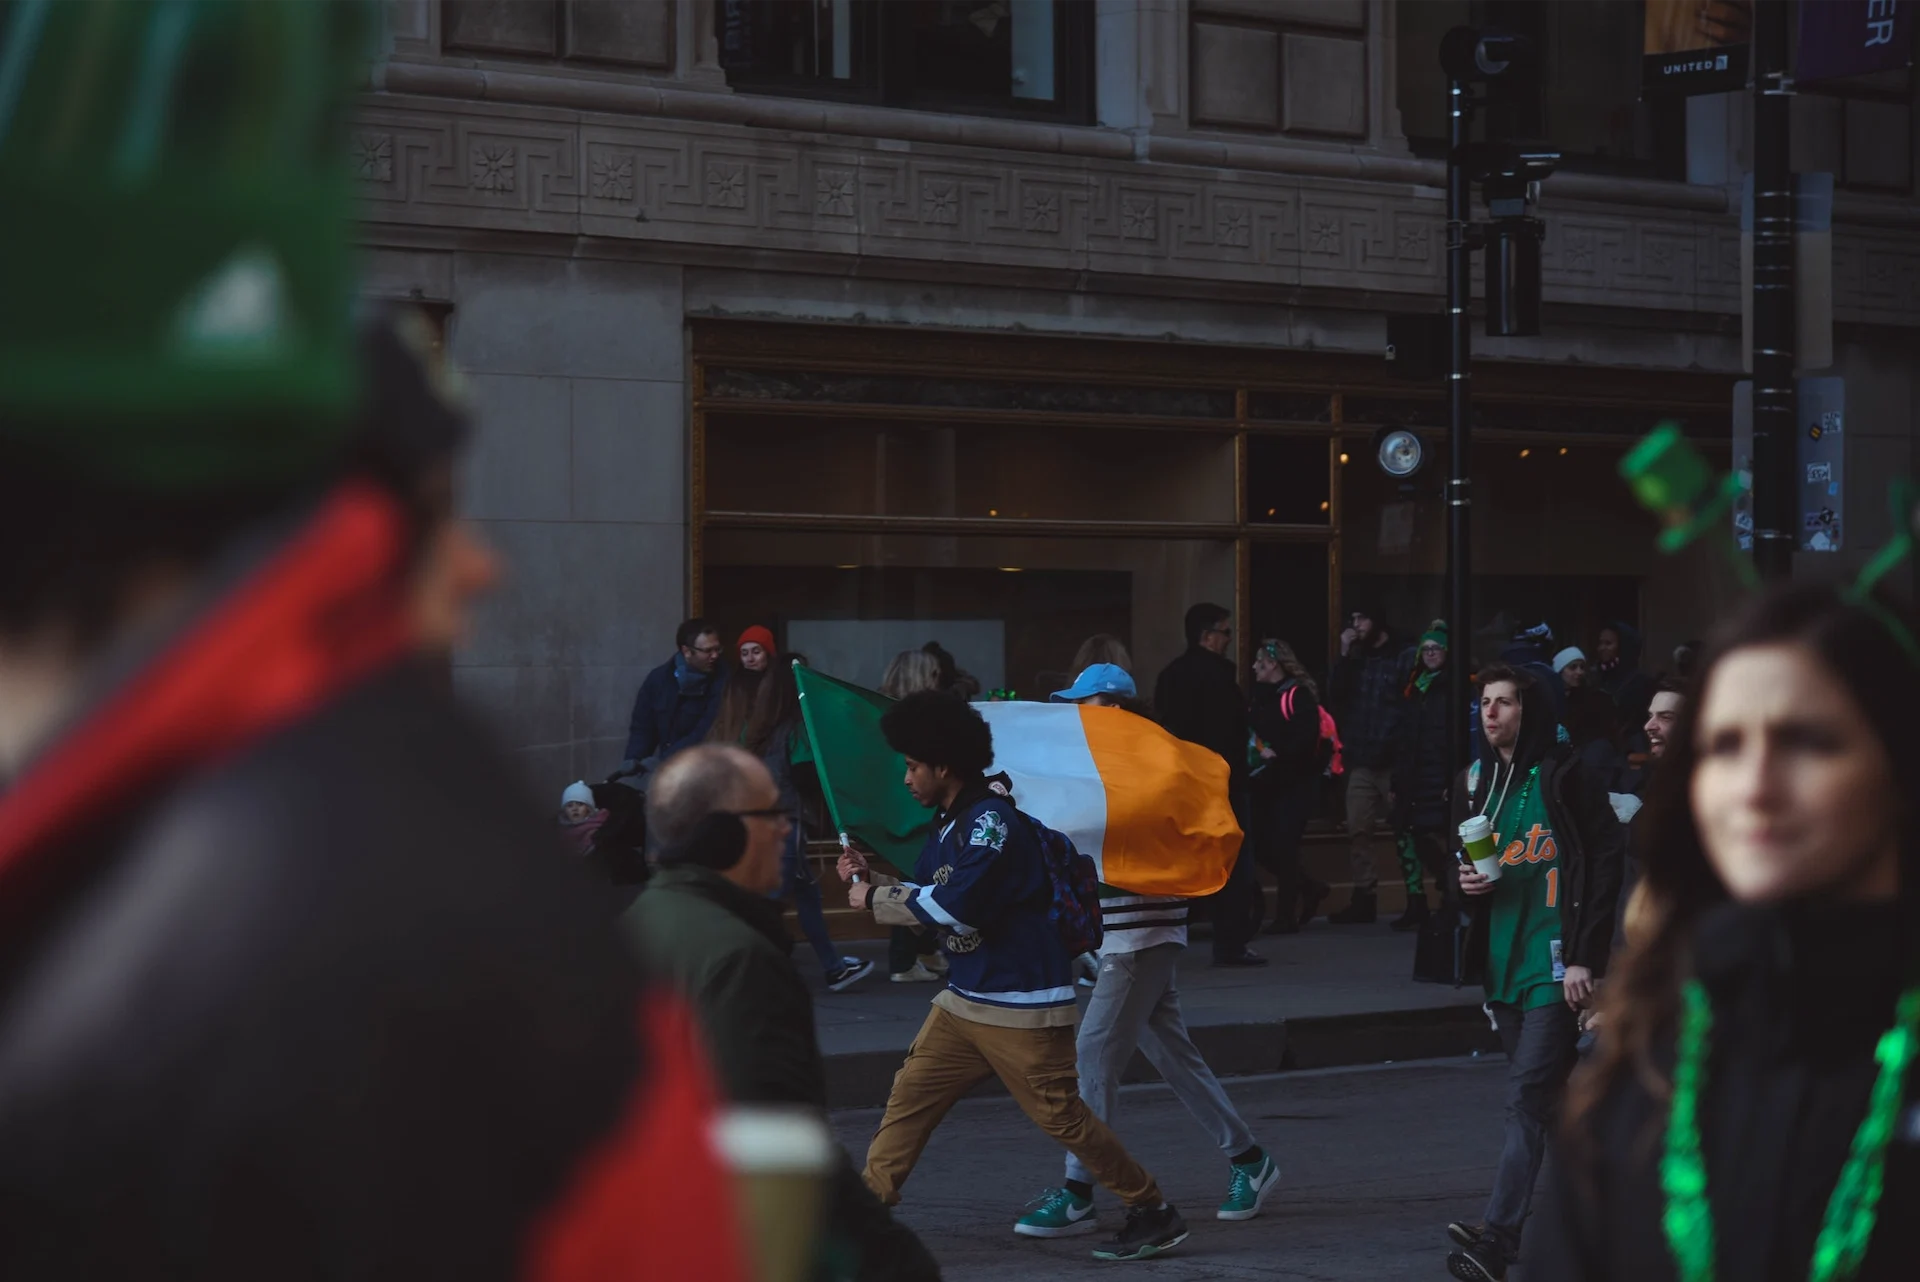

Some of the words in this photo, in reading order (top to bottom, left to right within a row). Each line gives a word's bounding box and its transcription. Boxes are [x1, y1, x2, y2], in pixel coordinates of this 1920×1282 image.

[1663, 60, 1713, 75] UNITED
[1492, 824, 1557, 867] ets
[1546, 867, 1558, 907] 1
